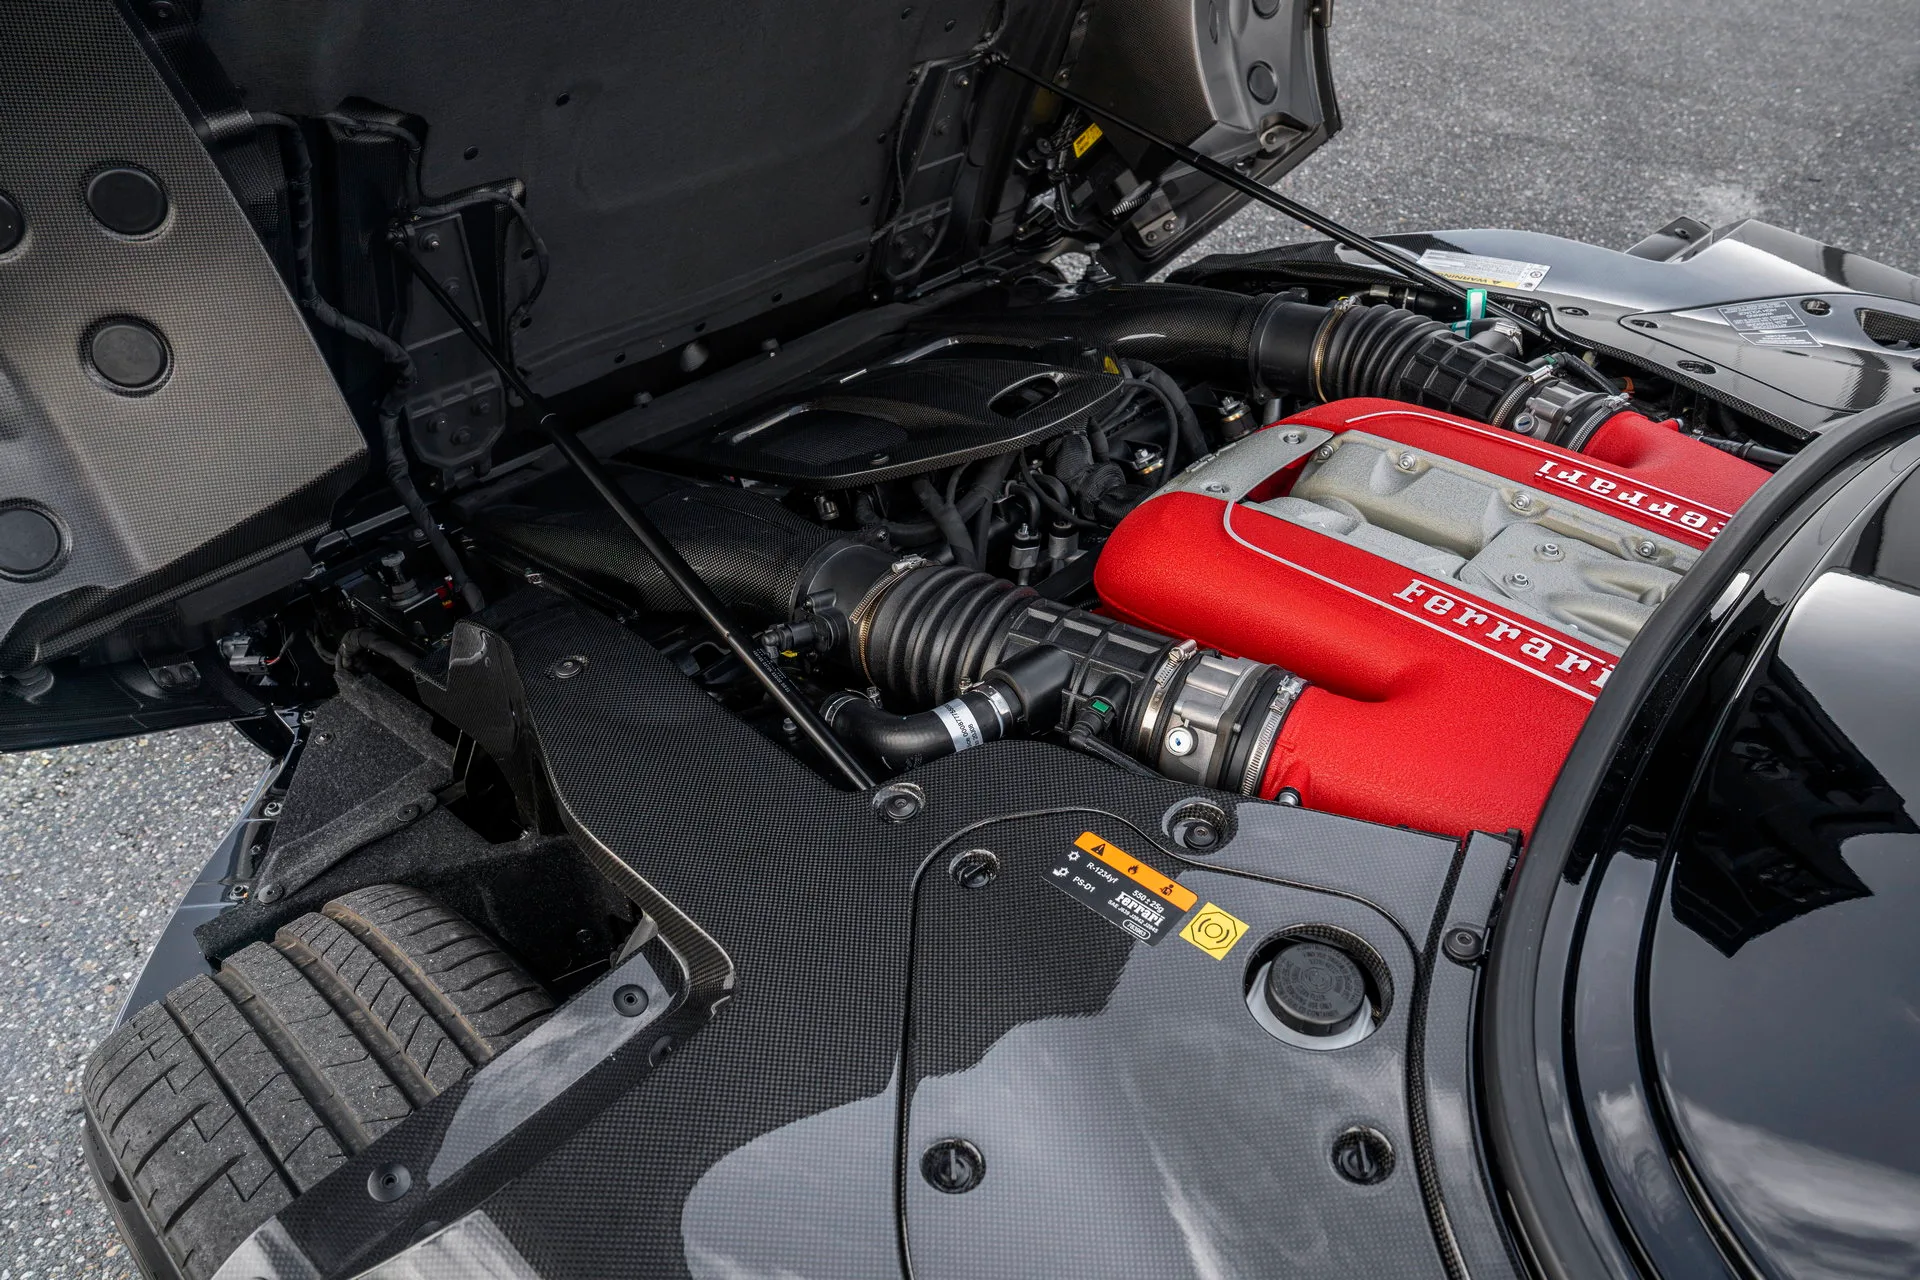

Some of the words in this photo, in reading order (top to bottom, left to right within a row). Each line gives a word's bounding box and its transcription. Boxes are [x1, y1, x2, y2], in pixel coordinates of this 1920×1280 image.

[1393, 578, 1616, 688] Ferrari
[1086, 861, 1119, 884] R-1234yf
[1072, 876, 1096, 893] PS-D1
[1107, 899, 1120, 909] SAE
[1114, 890, 1166, 927] Ferrari
